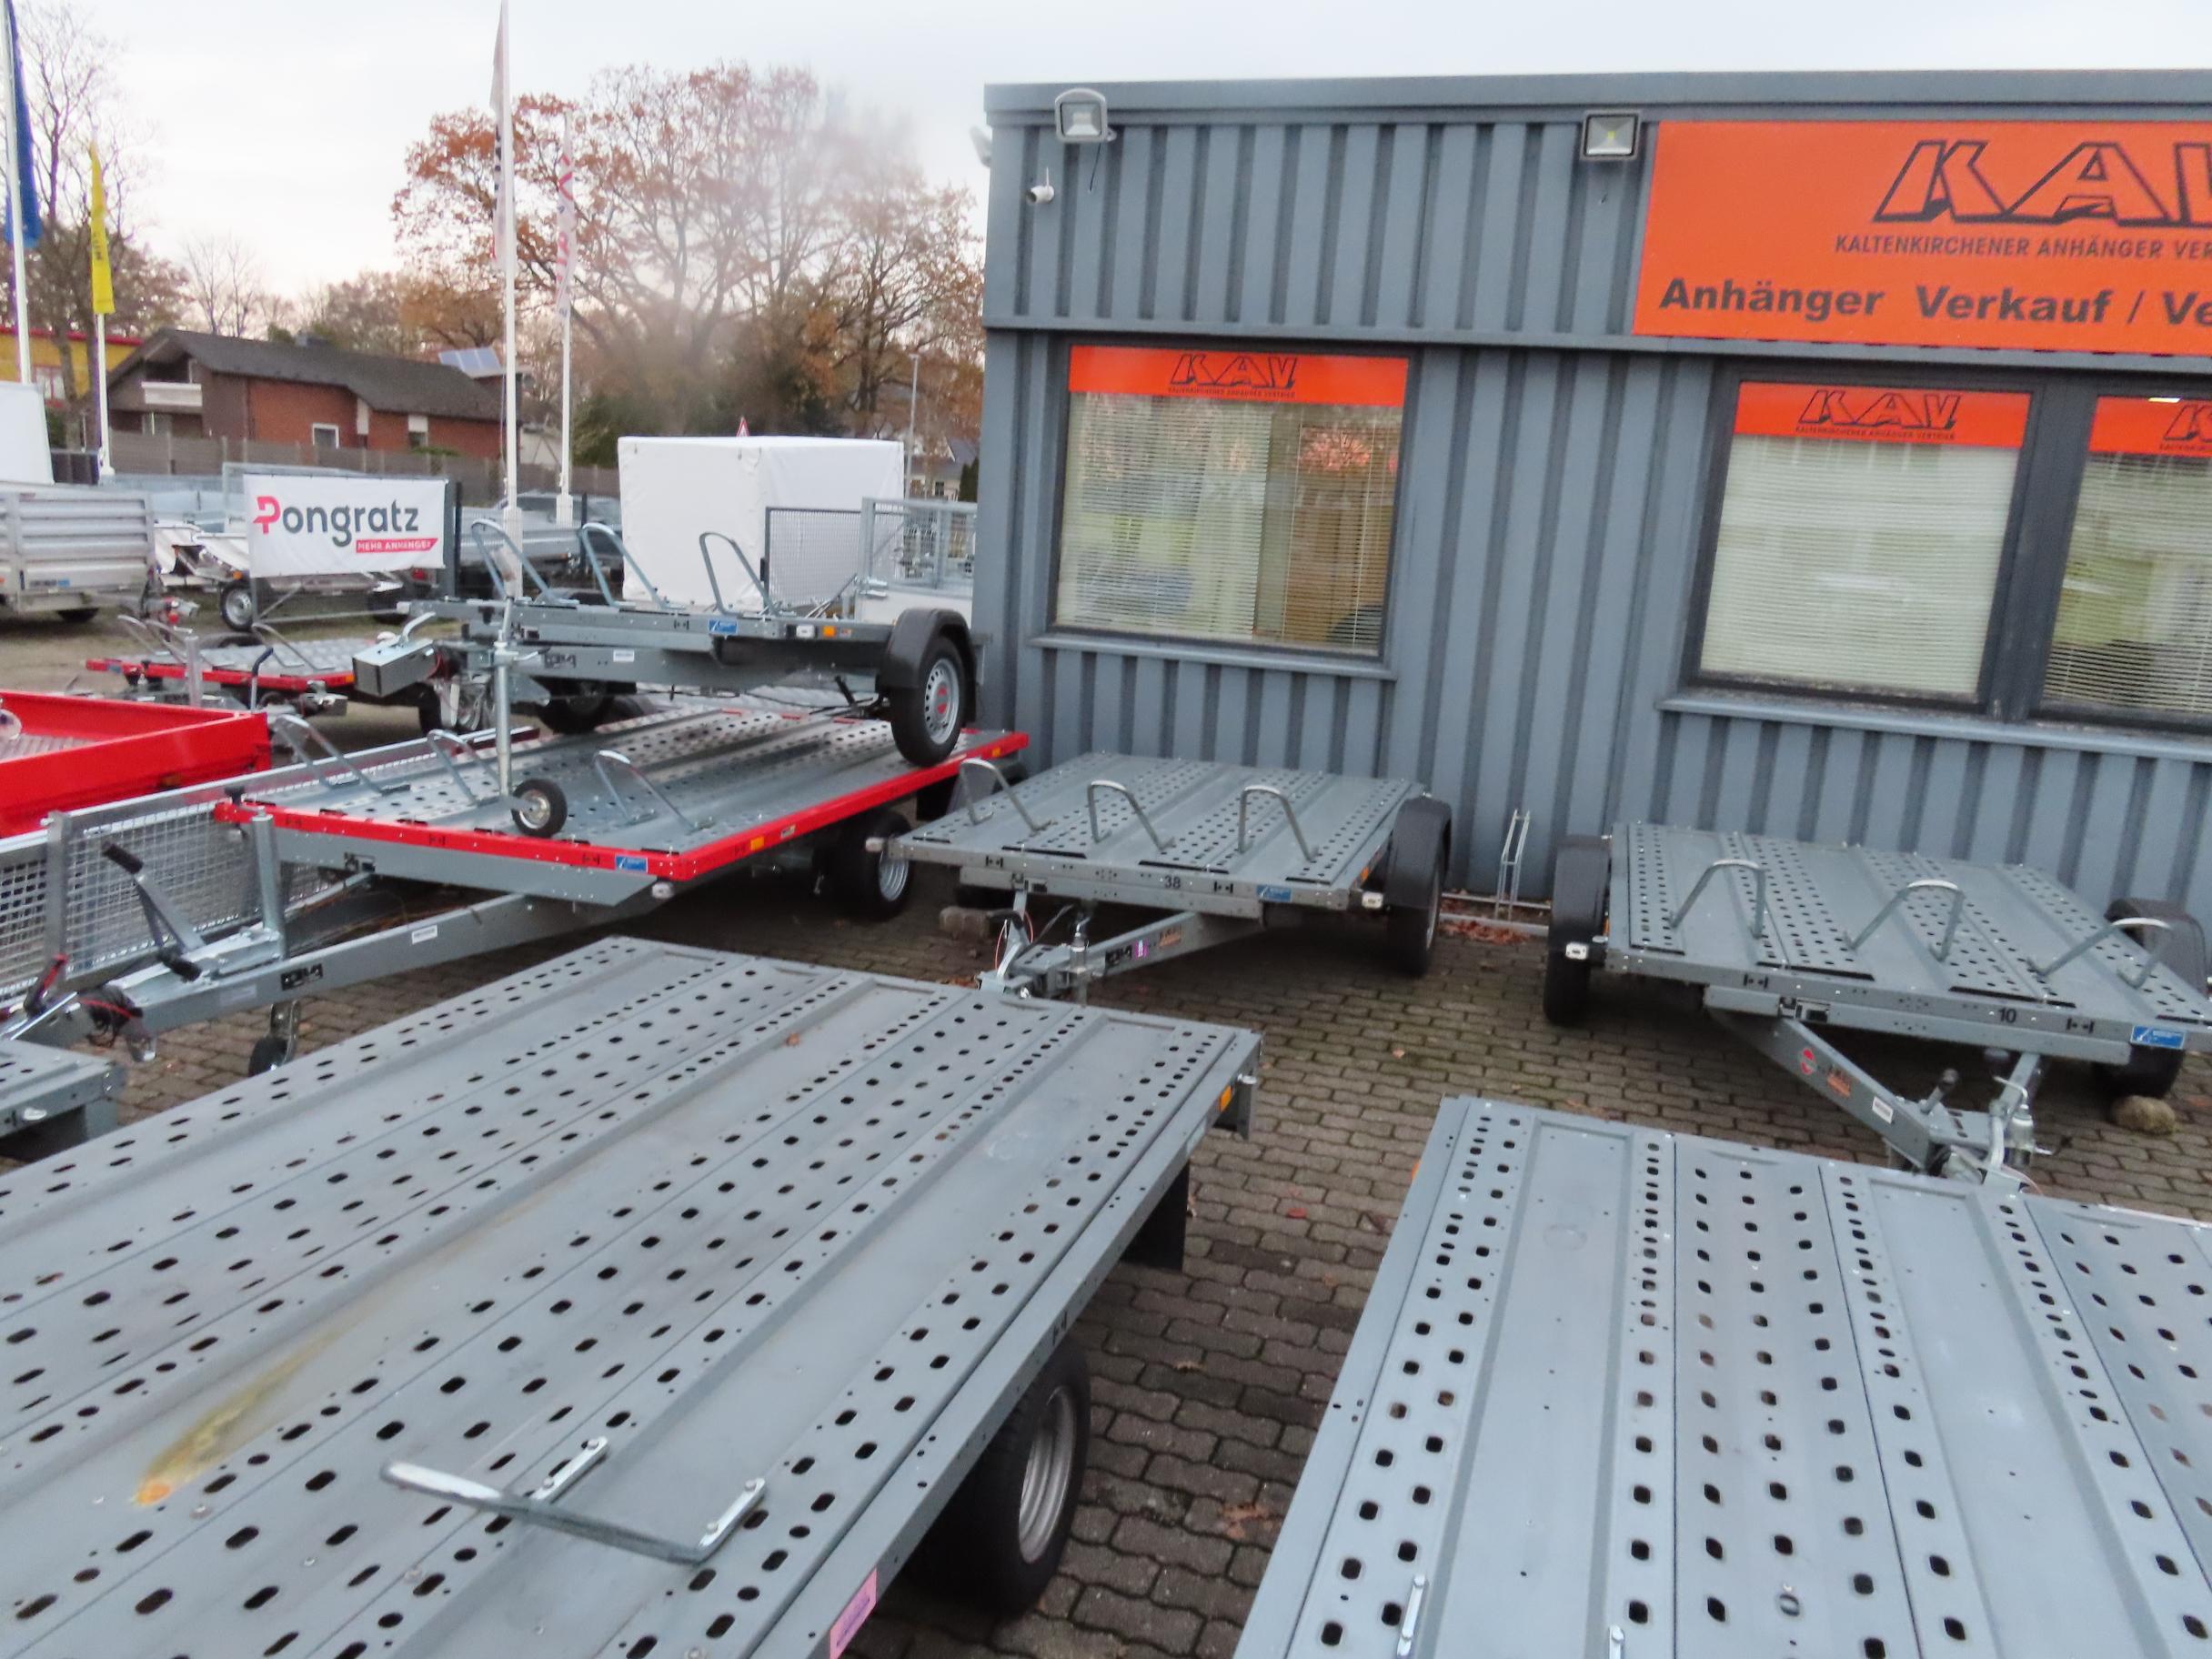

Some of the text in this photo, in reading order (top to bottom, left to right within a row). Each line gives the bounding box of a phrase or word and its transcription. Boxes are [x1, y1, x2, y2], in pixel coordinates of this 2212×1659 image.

[1835, 235, 2030, 257] KALTENKIRCHENER
[2036, 235, 2164, 259] ANHÄNGER
[1658, 276, 1885, 322] Anhänger
[1915, 285, 2115, 324] Verkauf
[1170, 354, 1297, 389] KAV
[1798, 389, 1961, 430] KAV
[253, 495, 419, 548] Pongratz
[1163, 874, 1181, 890] 38
[1997, 1006, 2017, 1024] 10
